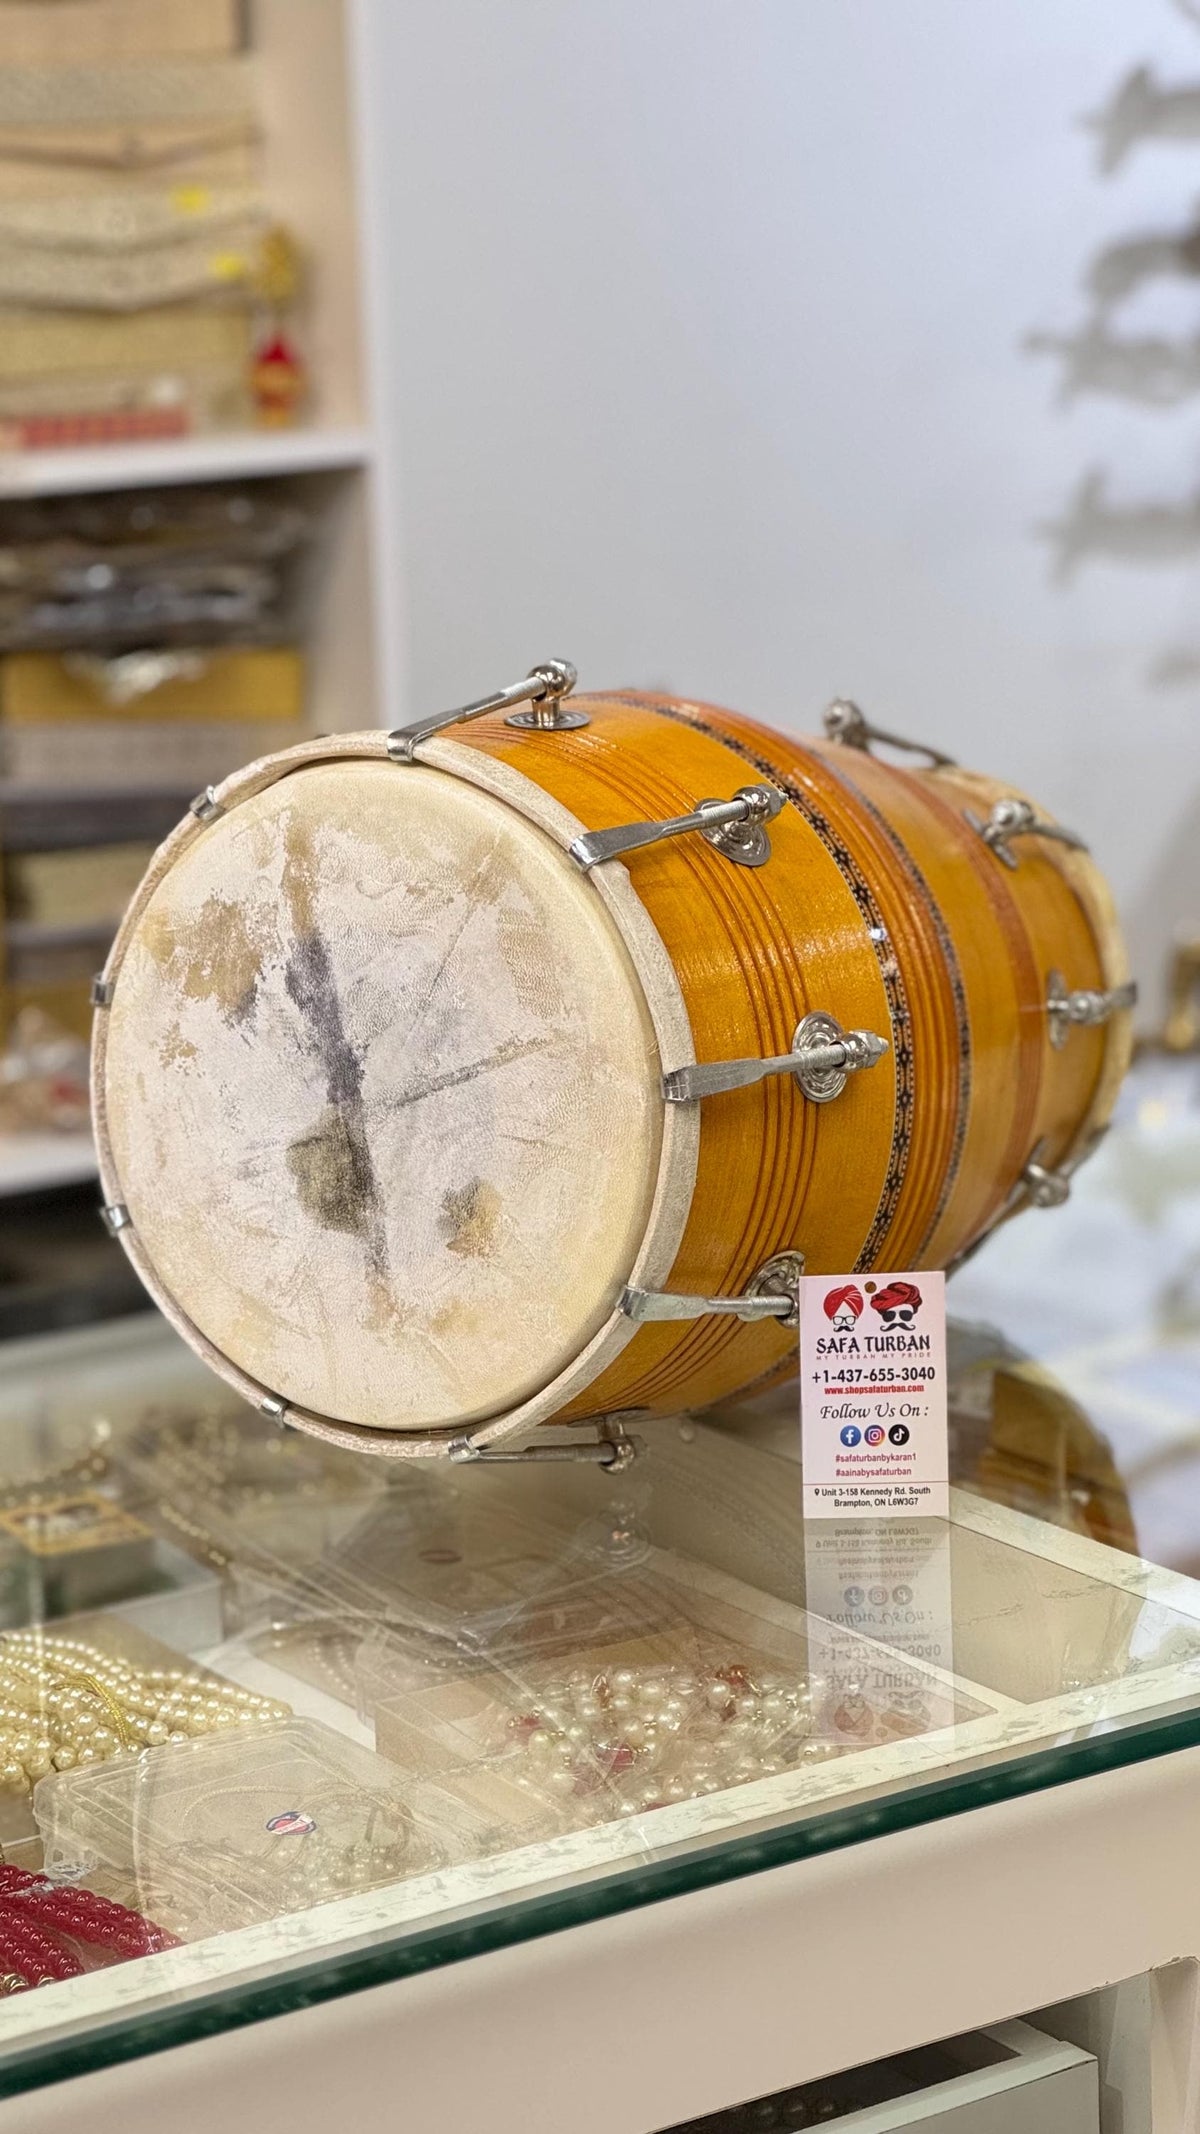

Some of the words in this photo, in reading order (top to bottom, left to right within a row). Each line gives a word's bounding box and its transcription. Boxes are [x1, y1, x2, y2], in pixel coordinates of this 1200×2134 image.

[816, 1337, 860, 1354] SAFA
[864, 1334, 930, 1352] TURBAN
[812, 1367, 935, 1383] +1-437-655-3040
[824, 1385, 924, 1395] www.shopsafaturban.com
[820, 1403, 871, 1419] Follow
[875, 1402, 895, 1417] Us
[835, 1452, 917, 1463] #safaturbanbykaran1
[836, 1467, 912, 1478] #aainabysafaturban
[821, 1488, 837, 1496] Unit
[838, 1488, 859, 1496] 3-158
[860, 1487, 892, 1497] Kennedy
[894, 1487, 907, 1495] Rd.
[909, 1486, 931, 1494] South
[834, 1498, 872, 1508] Brampton,
[874, 1498, 886, 1506] ON
[888, 1497, 918, 1506] L6W3G7
